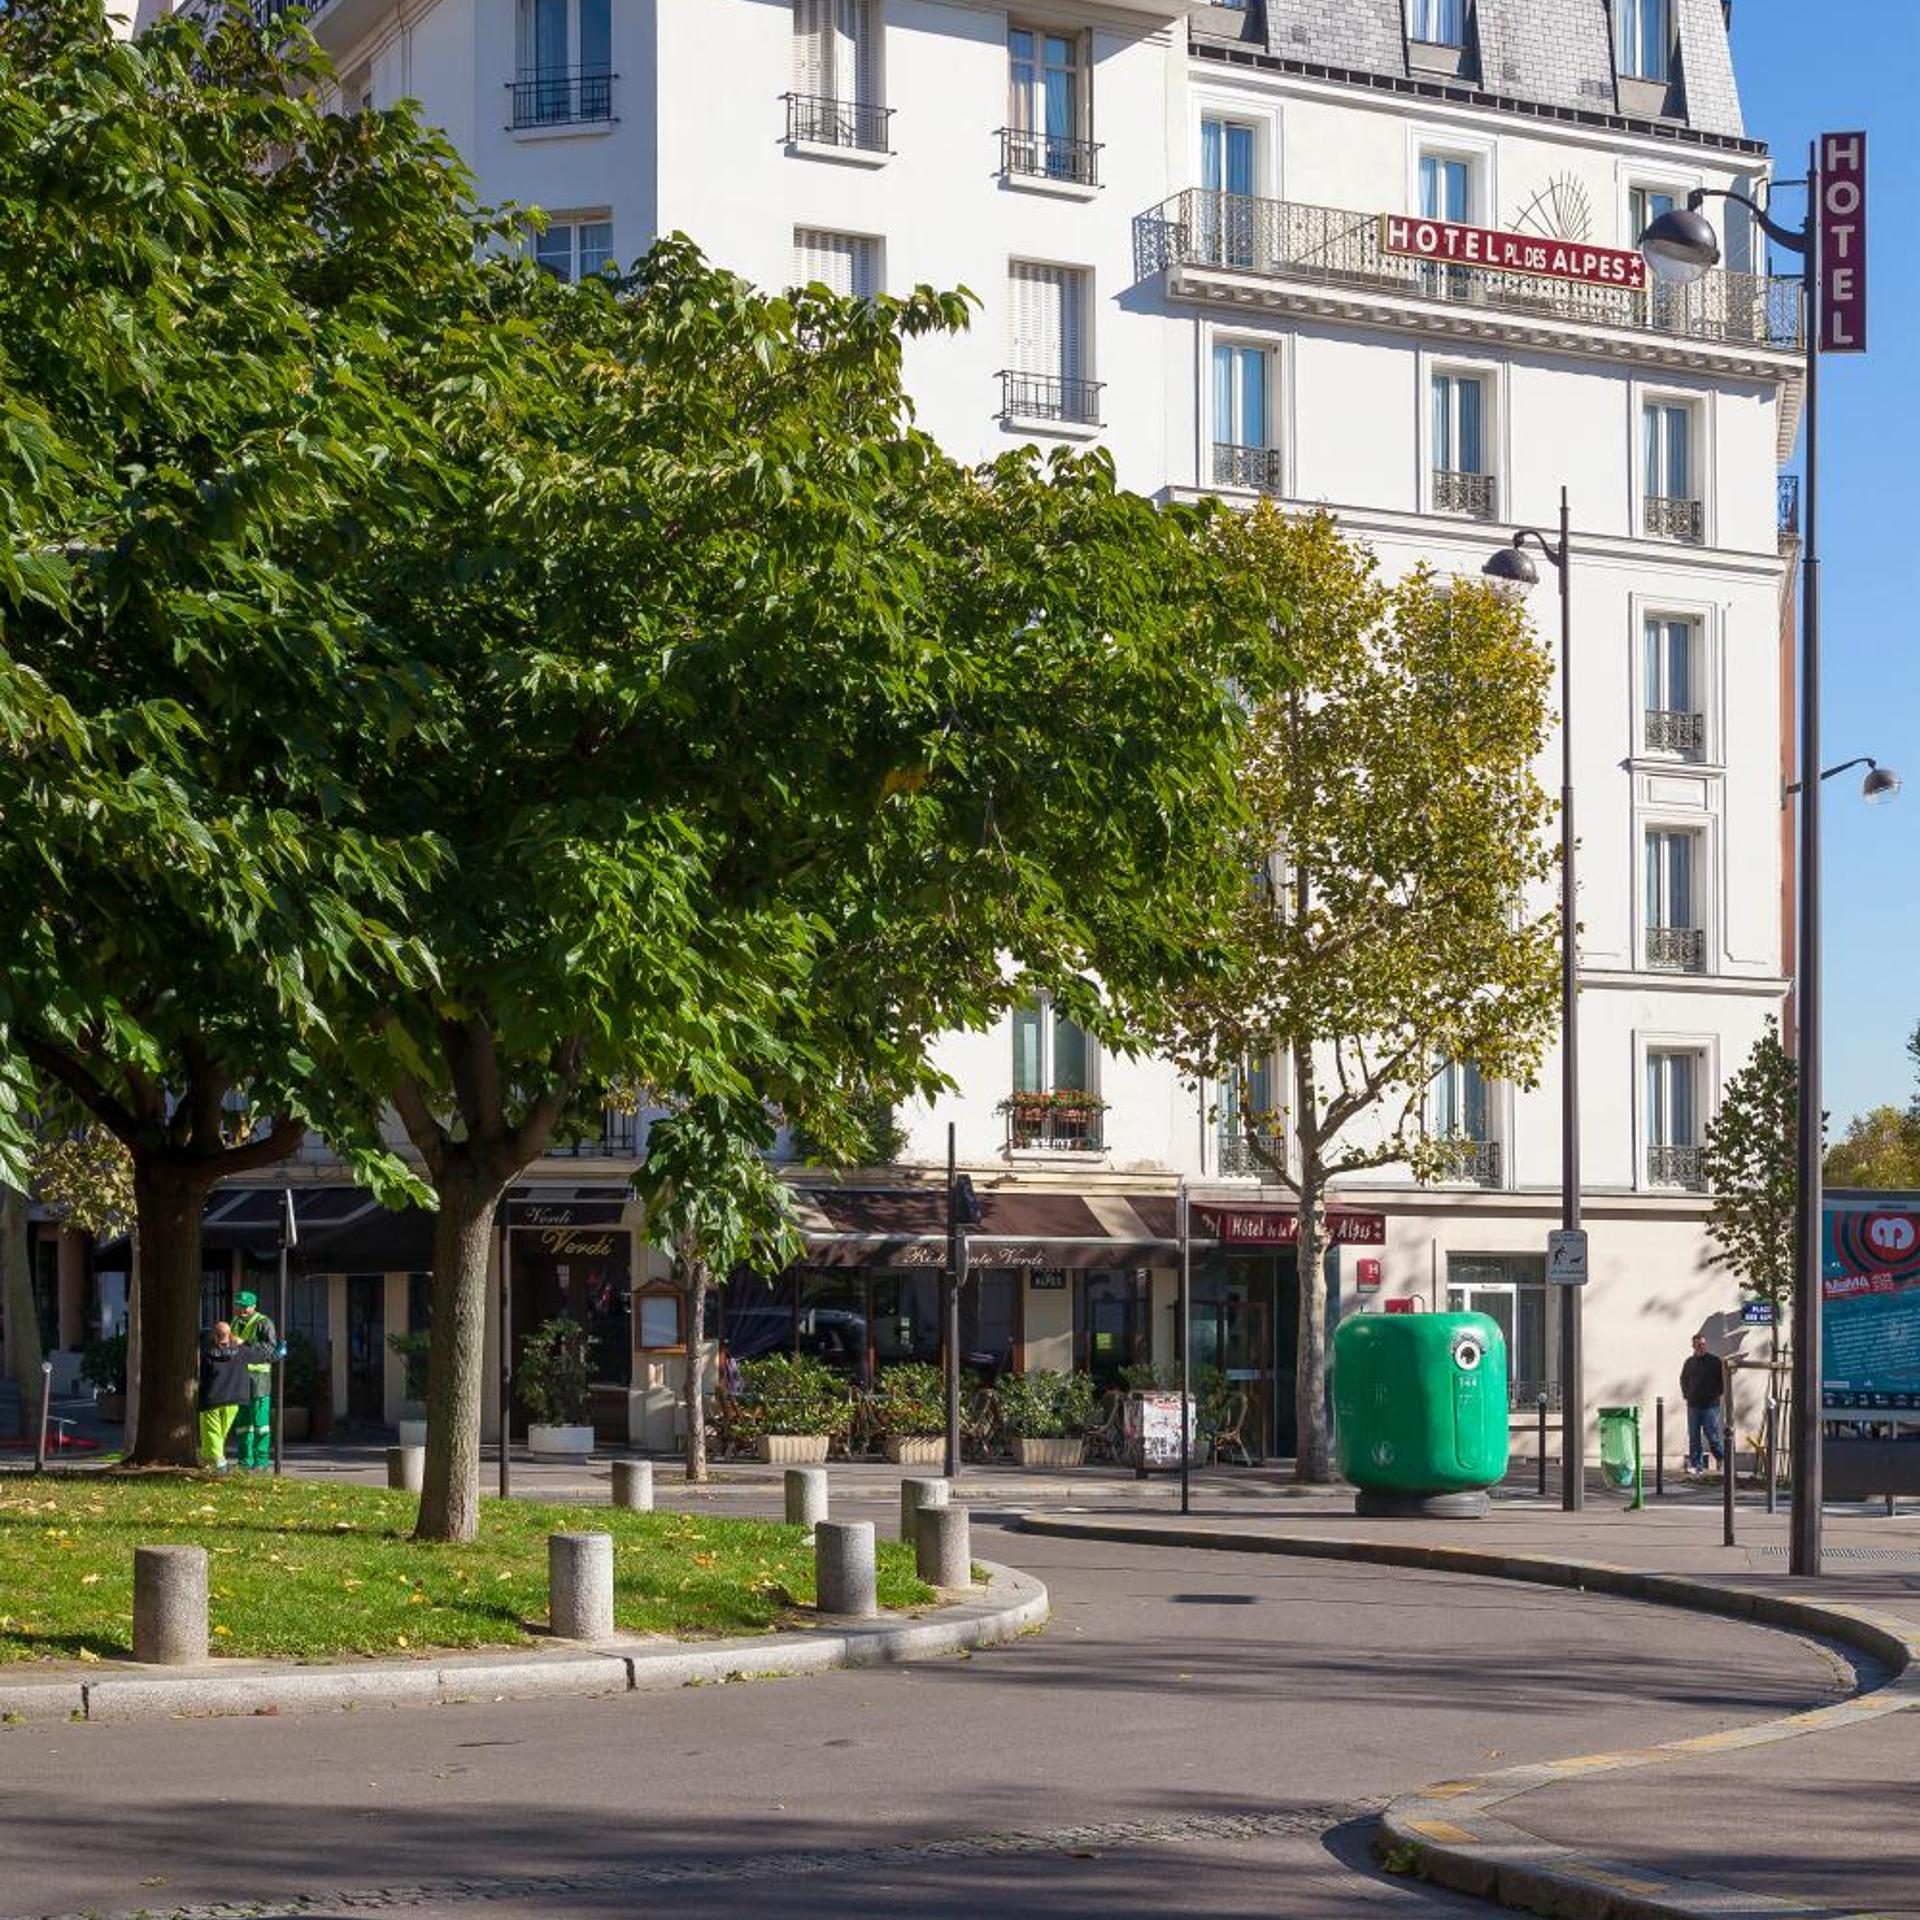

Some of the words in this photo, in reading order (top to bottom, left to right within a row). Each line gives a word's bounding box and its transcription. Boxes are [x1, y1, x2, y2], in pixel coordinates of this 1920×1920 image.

[1388, 219, 1500, 263] HOTEL
[1525, 247, 1546, 270] DES
[1552, 246, 1626, 281] ALPES
[1826, 137, 1861, 344] HOTEL
[541, 1228, 615, 1256] Verdi
[997, 1247, 1044, 1266] Verdi
